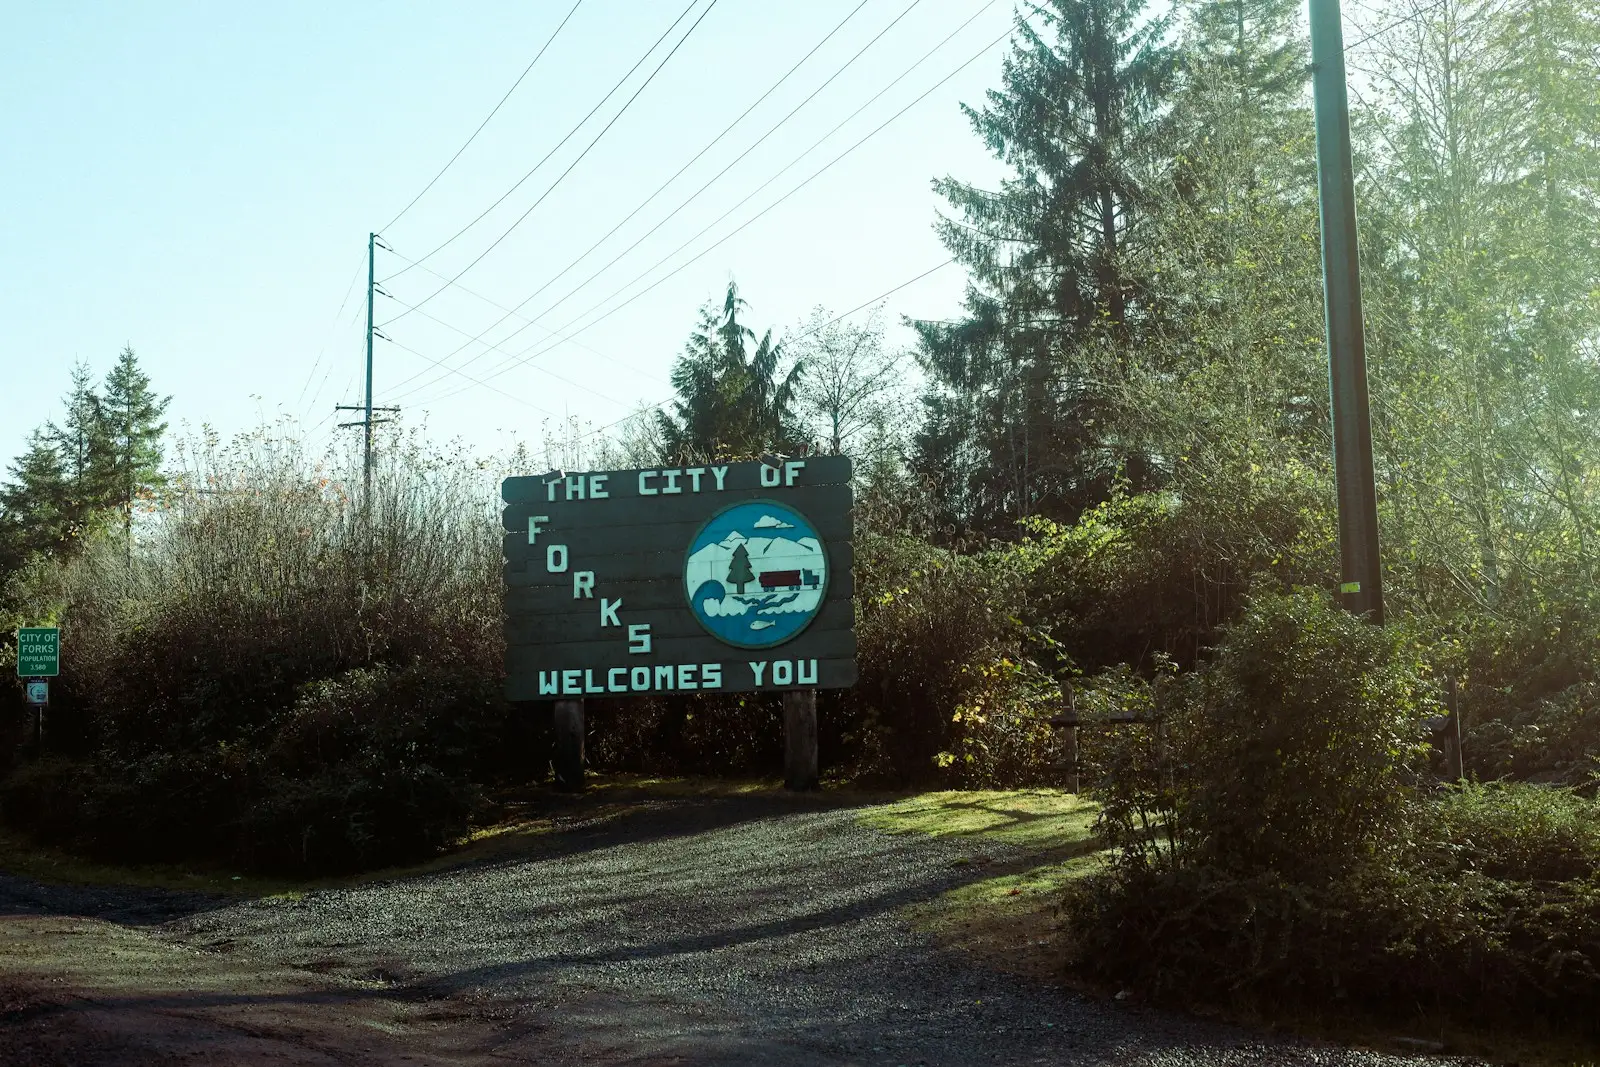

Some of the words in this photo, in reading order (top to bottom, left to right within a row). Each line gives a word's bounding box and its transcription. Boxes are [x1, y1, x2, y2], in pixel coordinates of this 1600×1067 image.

[544, 474, 610, 502] THE
[638, 466, 729, 495] CITY
[760, 461, 806, 487] OF
[528, 515, 652, 654] FORKS
[20, 634, 41, 642] CITY
[44, 634, 57, 642] OF
[22, 644, 54, 653] FORKS
[538, 663, 722, 695] WELCOMES
[749, 659, 818, 686] YOU
